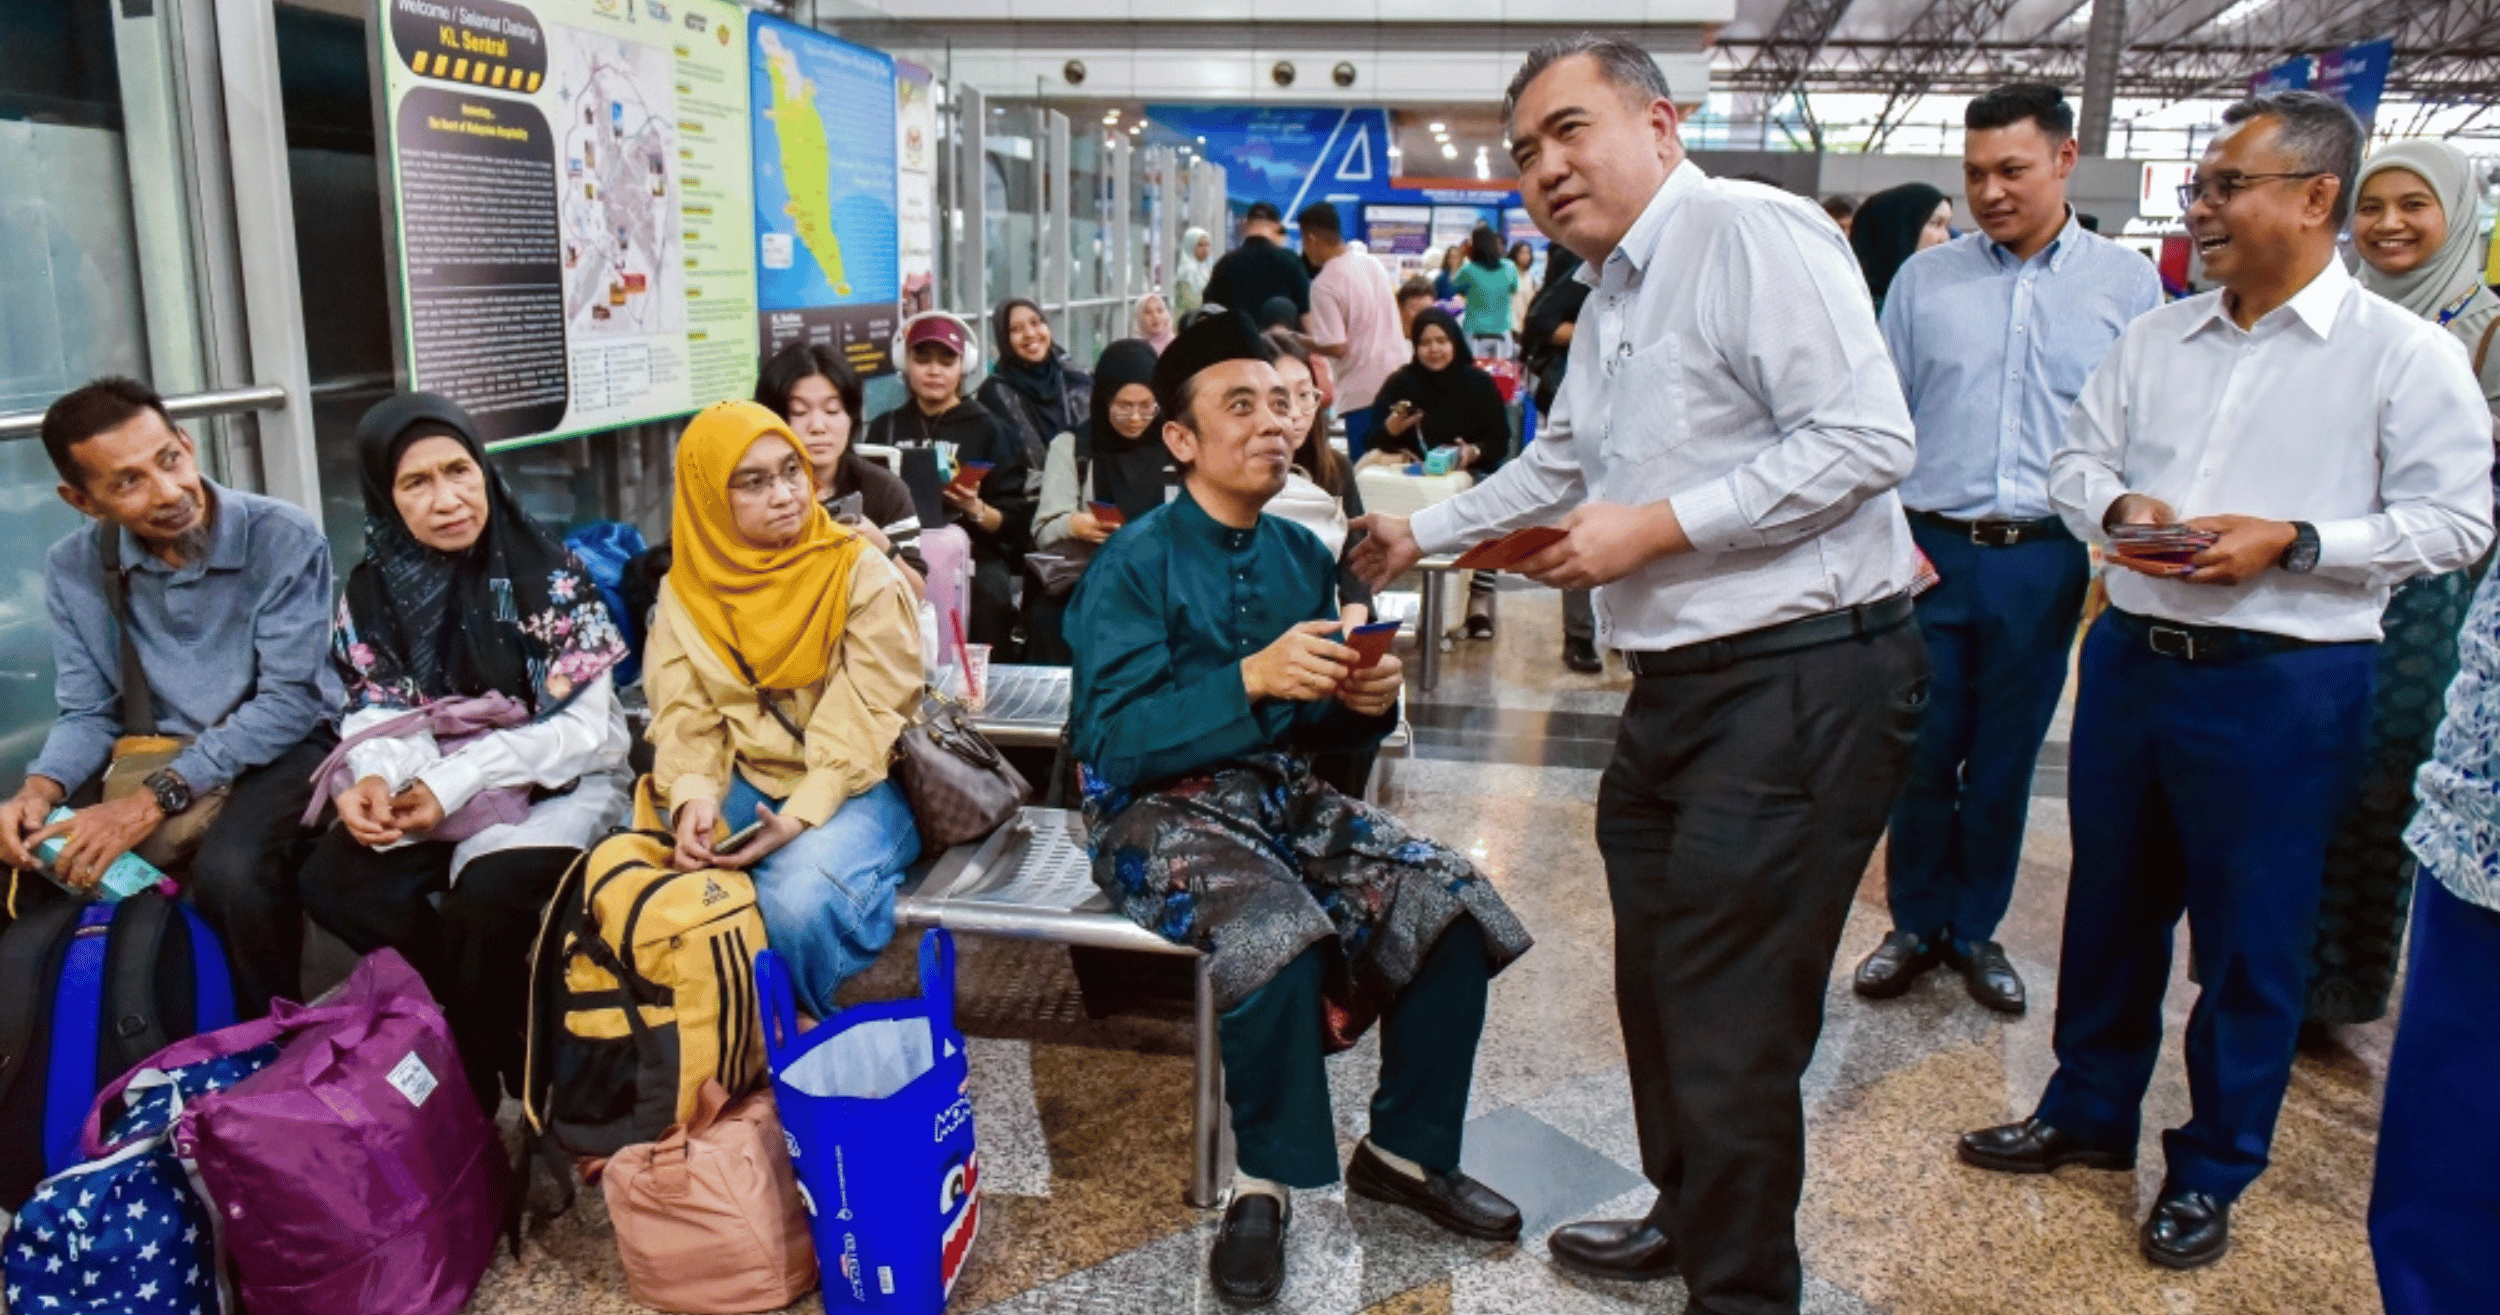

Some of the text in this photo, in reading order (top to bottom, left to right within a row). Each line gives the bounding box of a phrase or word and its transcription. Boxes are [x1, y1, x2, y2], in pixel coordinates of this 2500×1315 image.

[399, 0, 450, 20] Welcome
[459, 6, 501, 32] Selamat
[502, 18, 538, 44] Datang
[439, 25, 508, 58] KL Sentral
